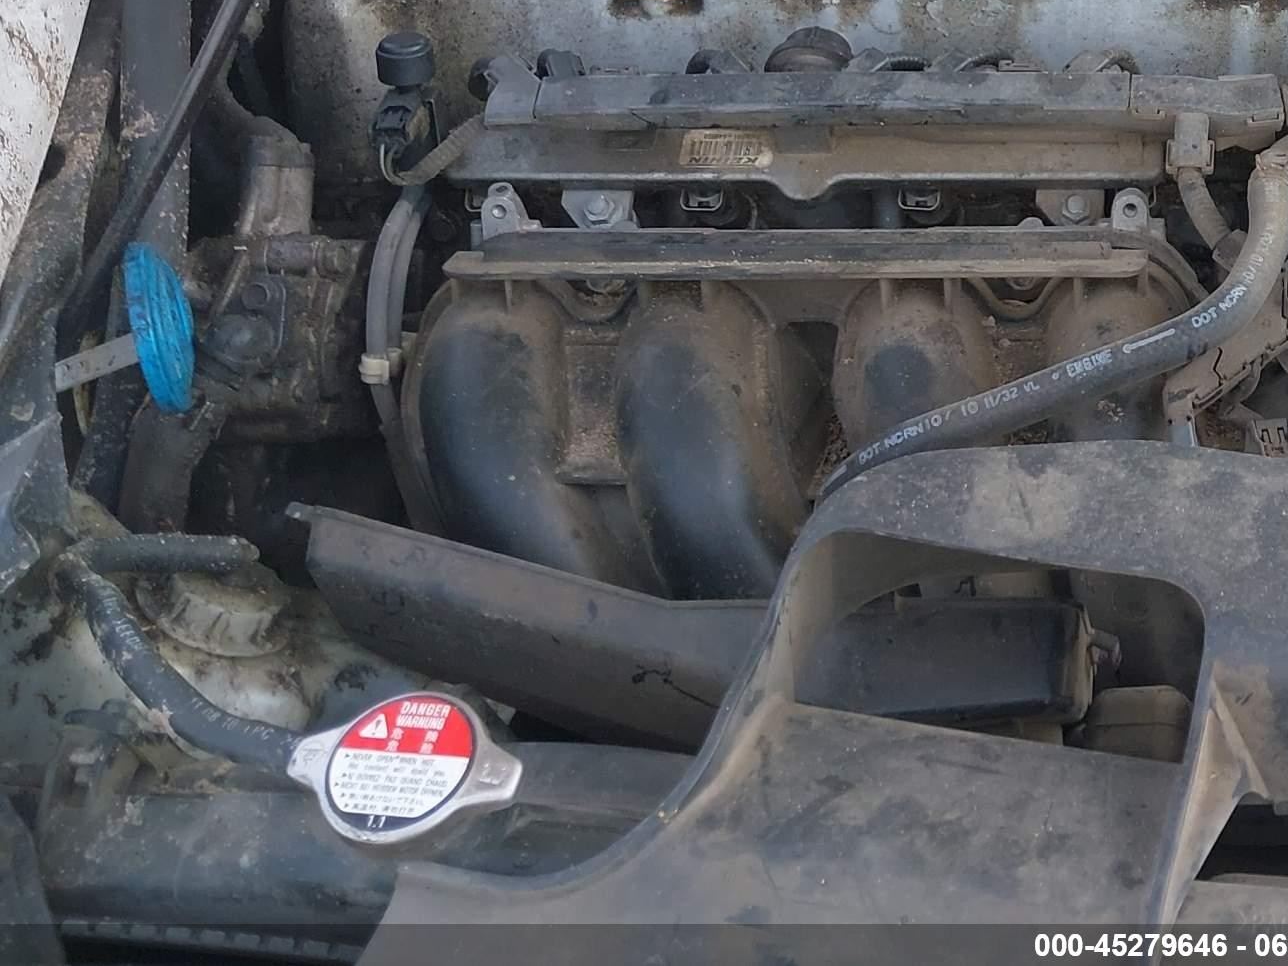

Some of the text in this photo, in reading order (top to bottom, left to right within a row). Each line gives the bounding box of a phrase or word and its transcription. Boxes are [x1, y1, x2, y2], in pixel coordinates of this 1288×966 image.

[1191, 306, 1218, 328] DOT
[858, 442, 882, 465] DOT
[400, 701, 451, 718] DANGER
[367, 814, 387, 828] 1.1
